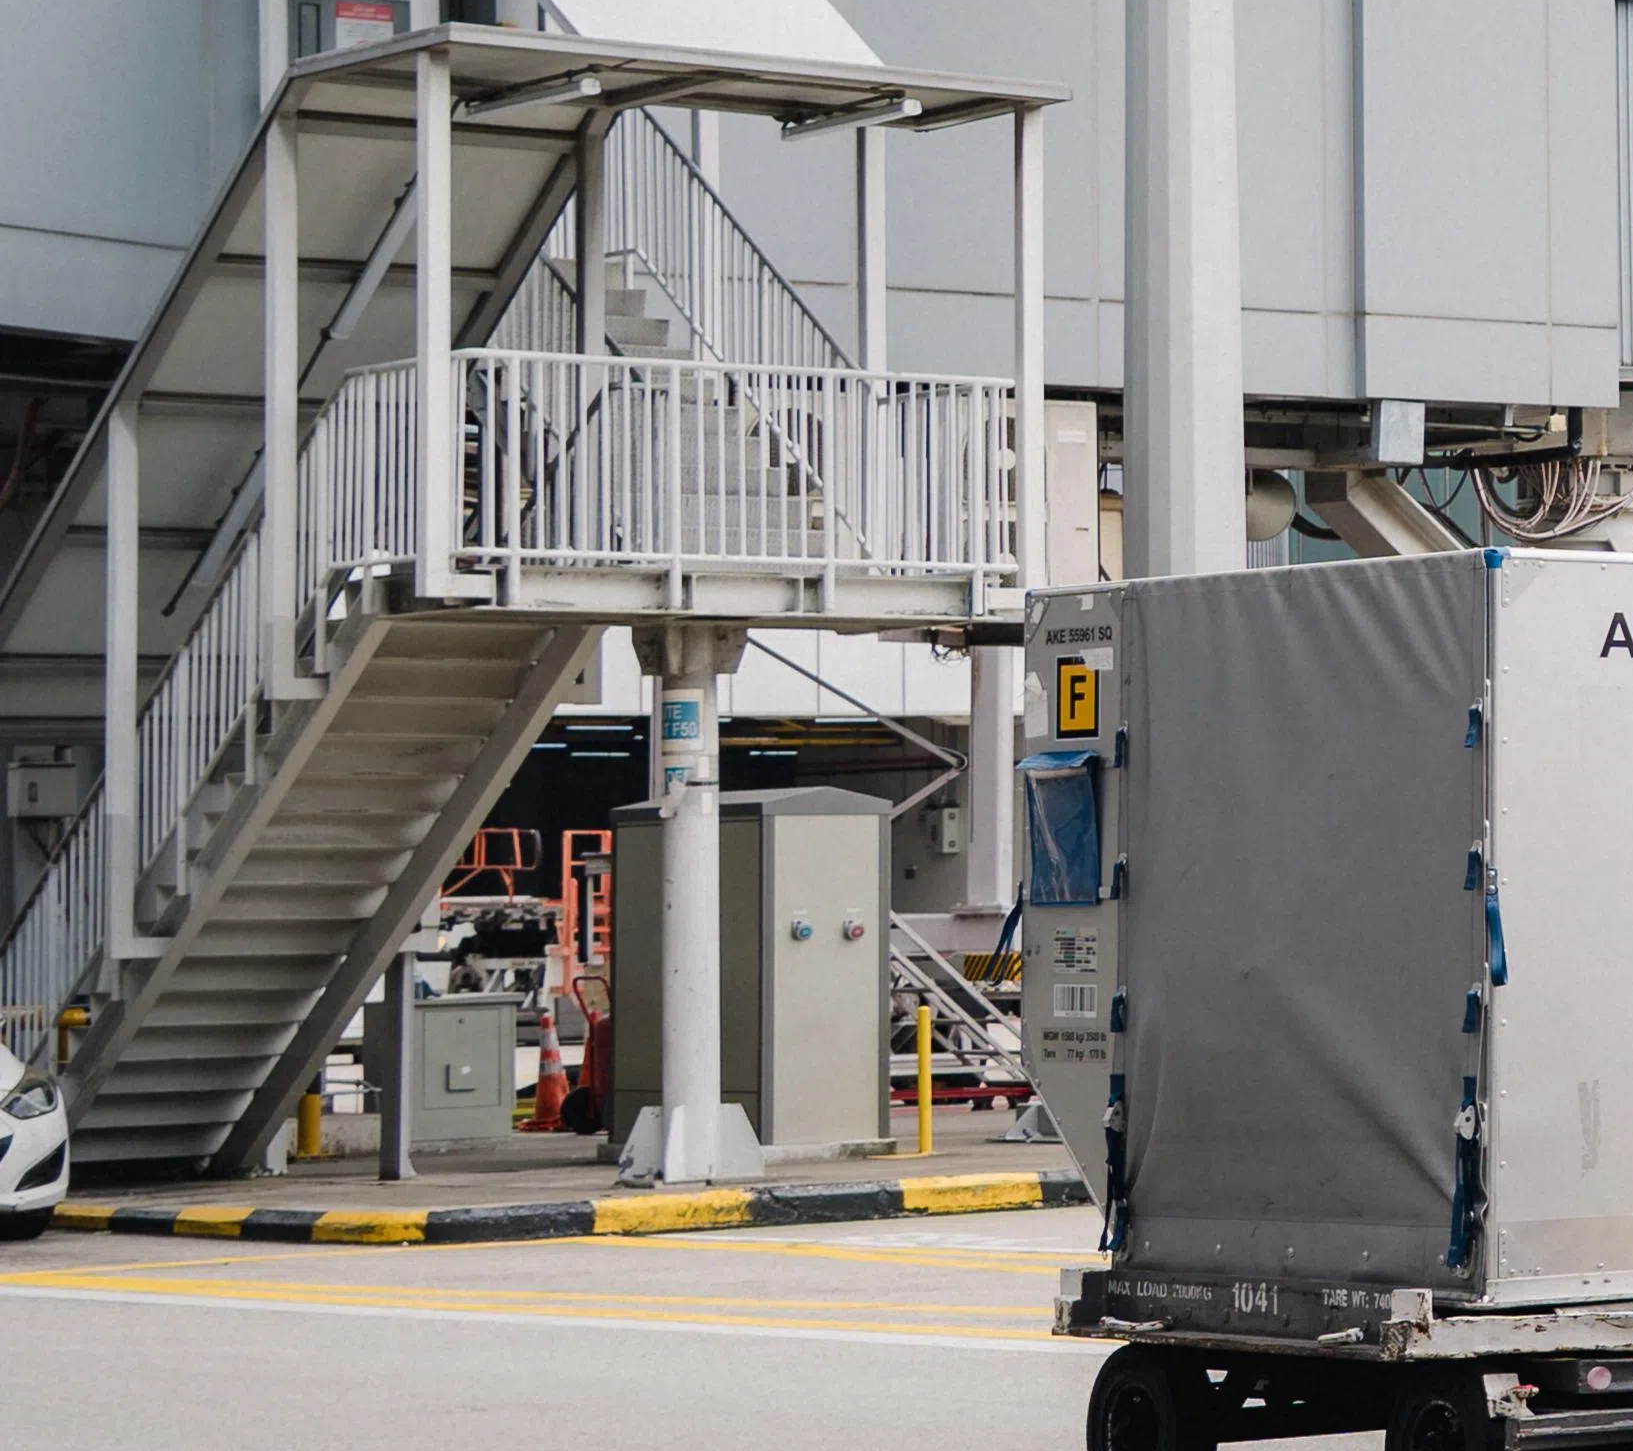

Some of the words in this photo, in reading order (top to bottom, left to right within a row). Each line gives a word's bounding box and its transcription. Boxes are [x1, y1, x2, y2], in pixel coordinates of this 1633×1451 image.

[1045, 629, 1066, 645] AKE
[1069, 627, 1095, 644] 55961
[1098, 626, 1113, 641] SQ
[1069, 674, 1087, 720] F
[1108, 1279, 1131, 1296] MAX
[1137, 1281, 1168, 1298] LOAD
[1231, 1282, 1279, 1315] 1041
[1322, 1288, 1348, 1308] TARE
